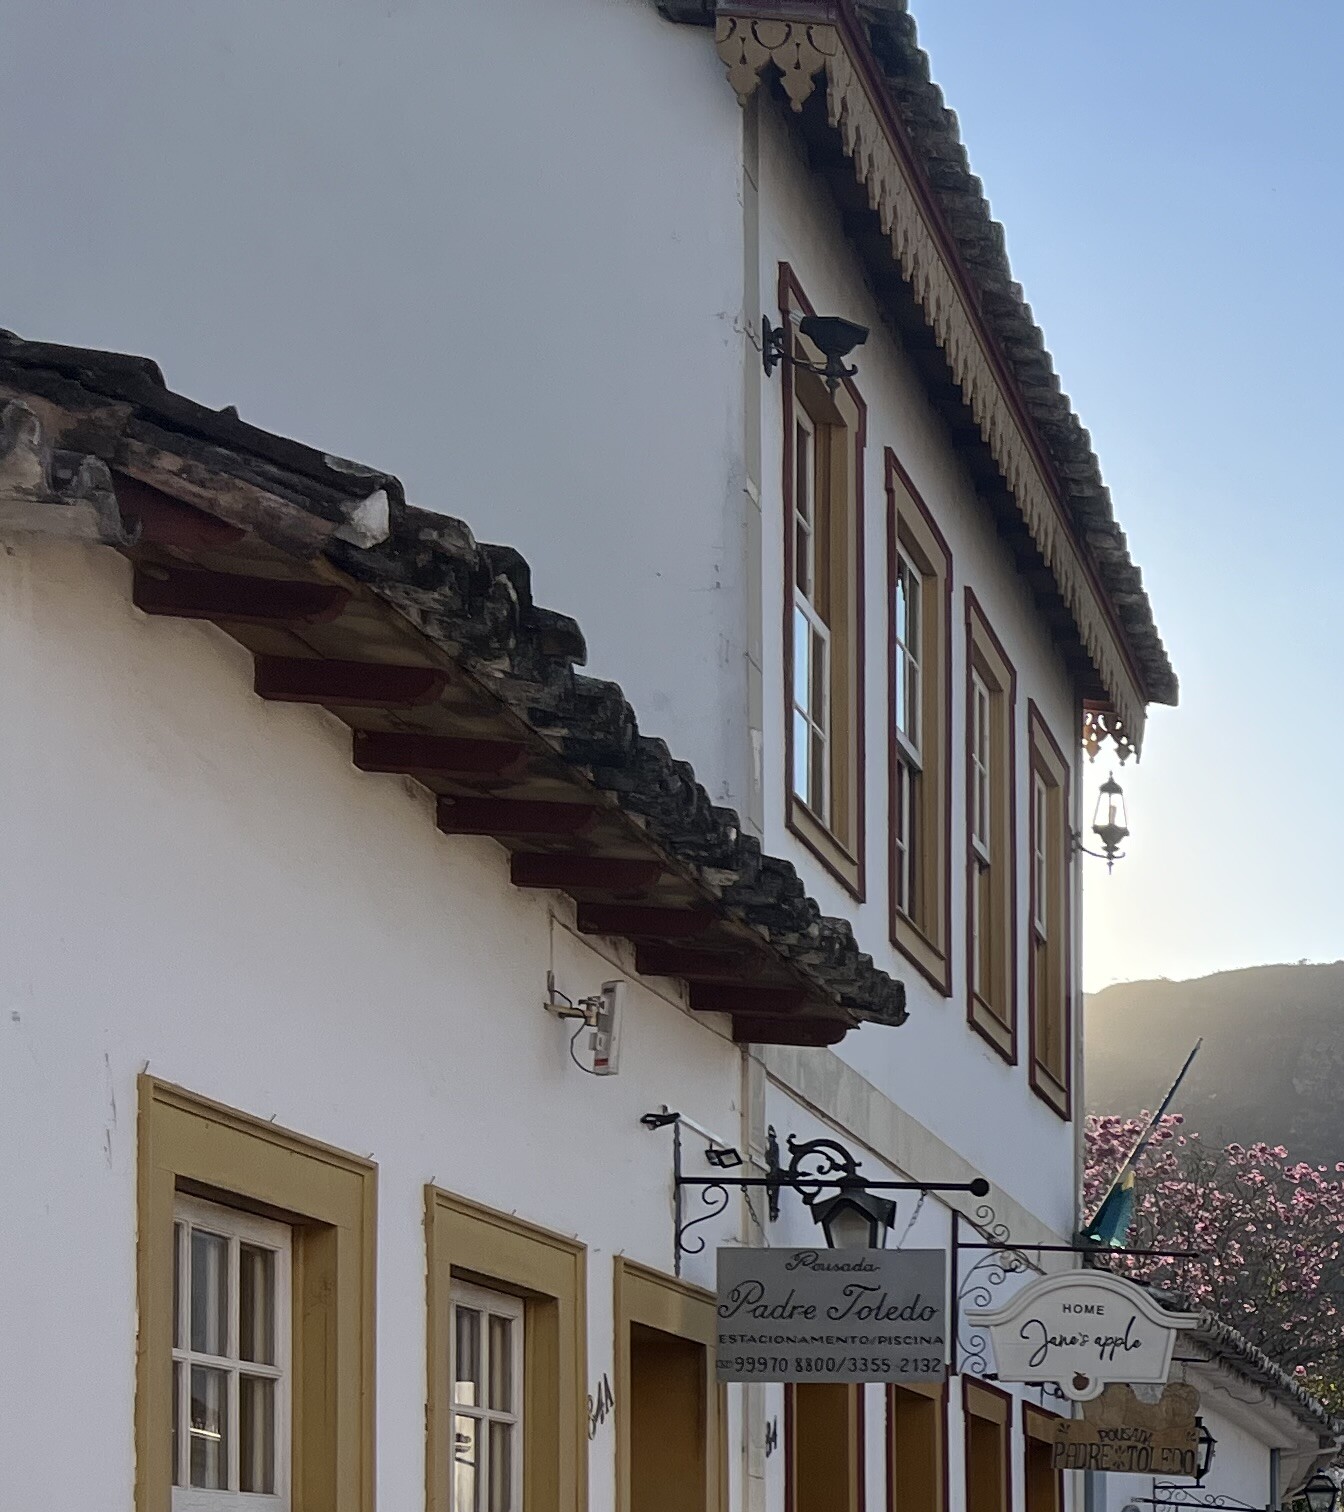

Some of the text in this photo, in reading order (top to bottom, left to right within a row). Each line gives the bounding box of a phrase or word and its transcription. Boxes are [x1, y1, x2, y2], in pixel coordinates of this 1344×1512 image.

[785, 1251, 880, 1272] Pousada
[718, 1280, 938, 1321] Padre Toledo
[1063, 1304, 1105, 1315] HOME
[1020, 1316, 1142, 1368] Jane's apple
[735, 1357, 941, 1373] 99970 8800/3355 2132
[1054, 1441, 1195, 1474] PADRE TOLEDO
